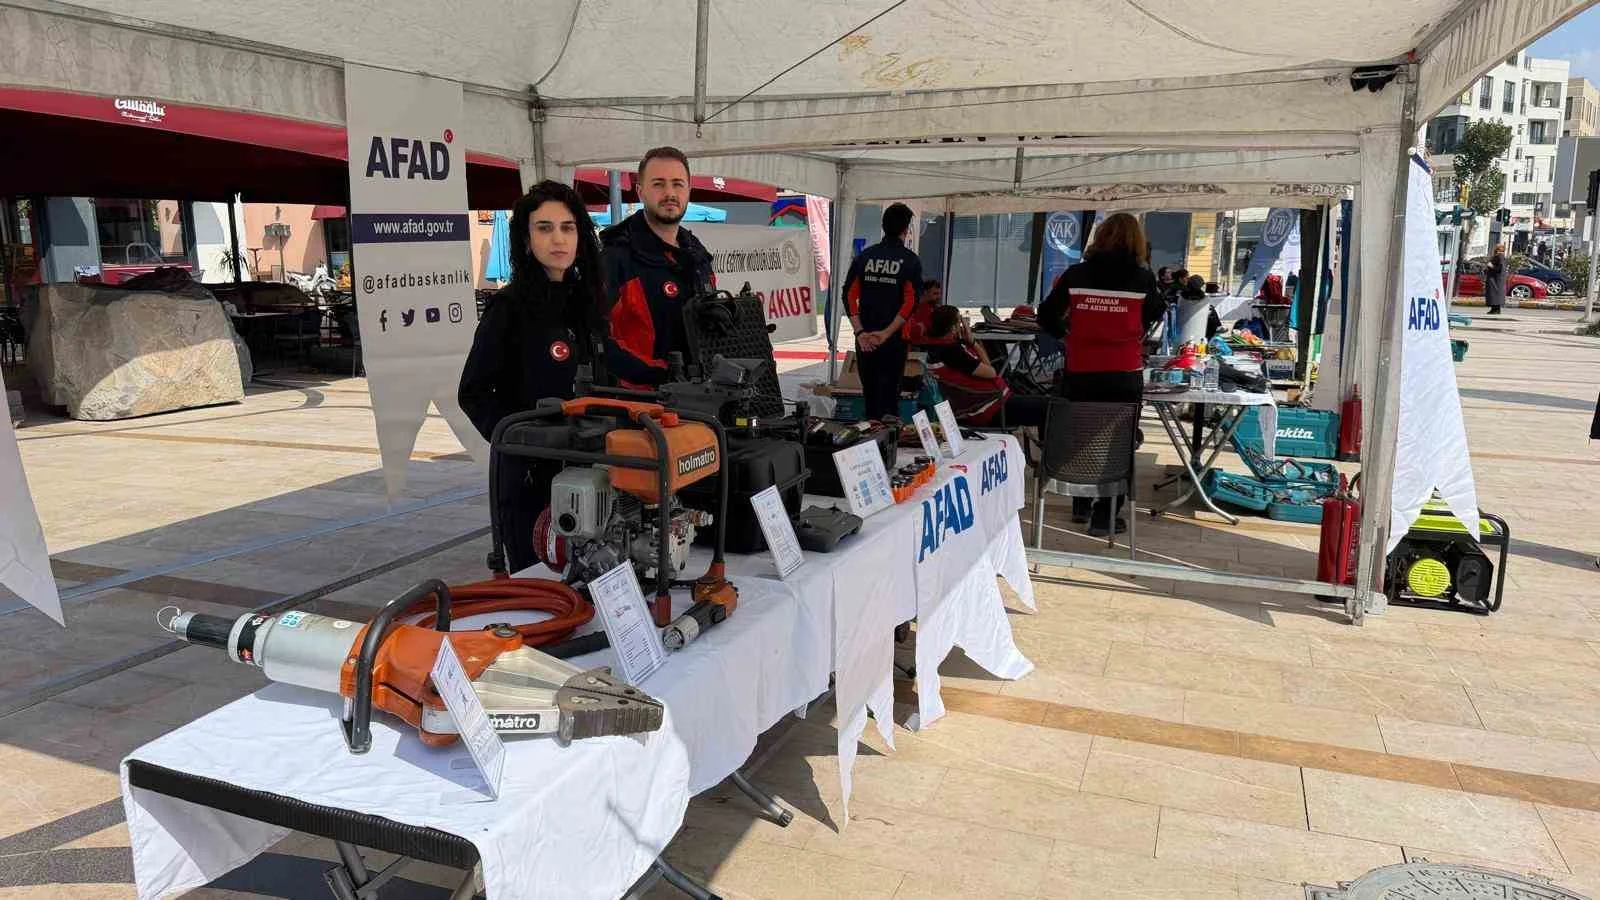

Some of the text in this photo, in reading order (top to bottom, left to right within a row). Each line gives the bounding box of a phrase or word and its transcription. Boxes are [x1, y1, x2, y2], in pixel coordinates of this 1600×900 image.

[365, 136, 450, 181] AFAD
[373, 218, 454, 237] www.afad.gov.tr
[864, 259, 901, 275] AFAD
[362, 270, 470, 294] @afadbaskanlik
[768, 286, 811, 320] AKUB
[1408, 296, 1440, 331] AFAD
[1275, 427, 1314, 440] akita
[679, 450, 716, 473] holmatro
[981, 449, 1008, 496] AFAD
[918, 475, 974, 564] AFAD
[490, 716, 537, 729] matro
